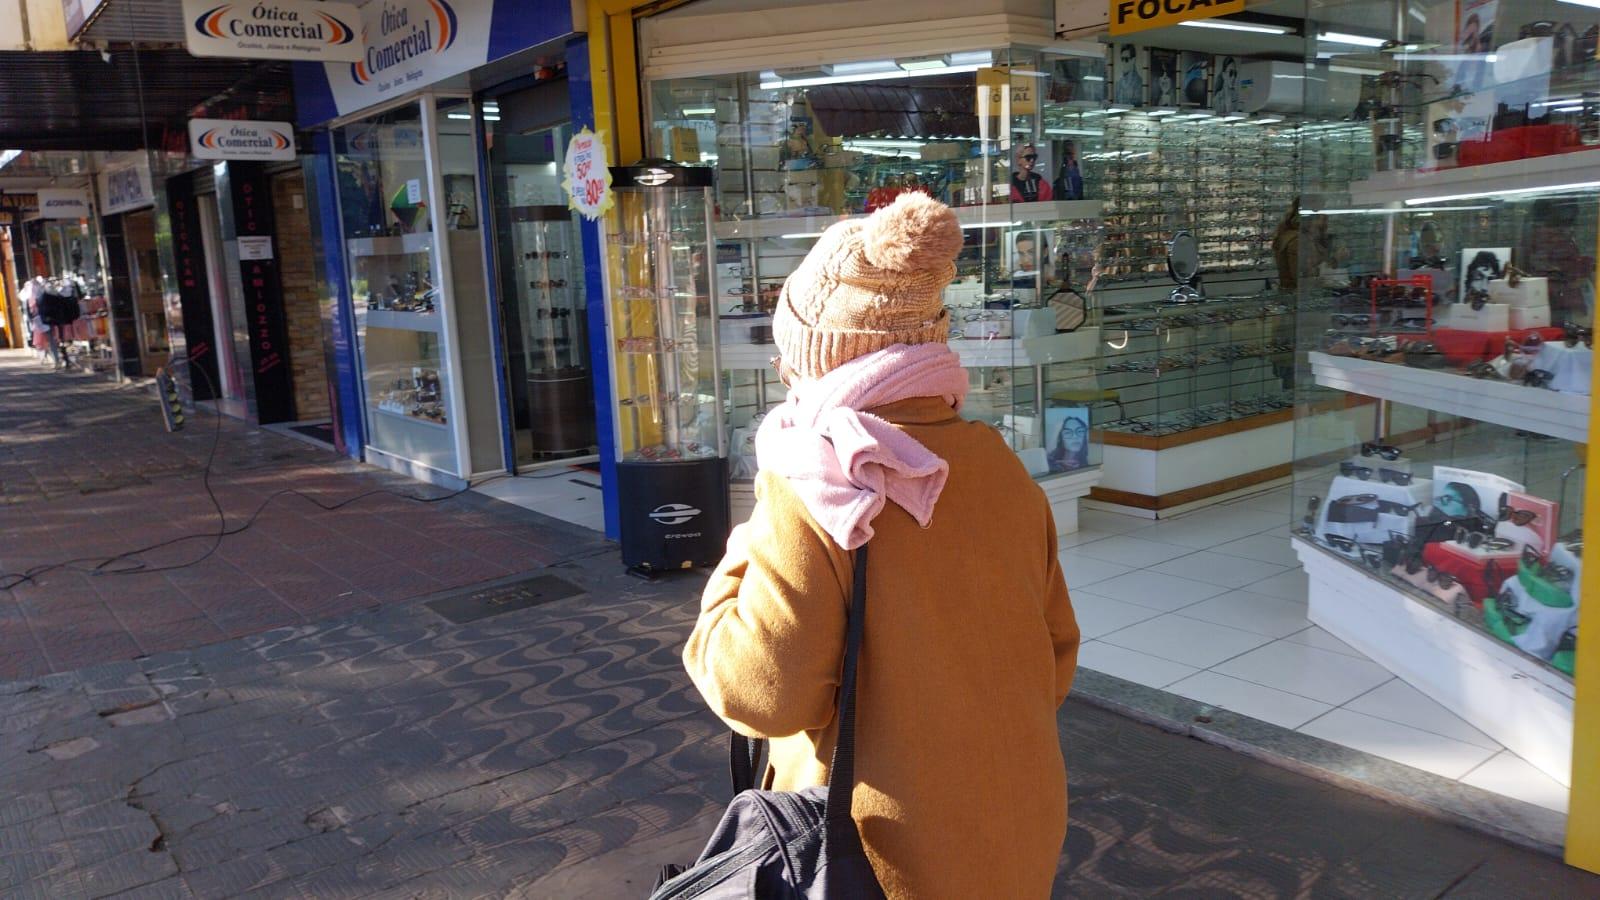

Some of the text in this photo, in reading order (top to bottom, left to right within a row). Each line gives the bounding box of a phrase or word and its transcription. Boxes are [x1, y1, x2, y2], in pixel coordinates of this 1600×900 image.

[252, 2, 299, 21] Ótica
[381, 1, 409, 36] Ótica
[1118, 0, 1235, 24] FOC
[230, 19, 323, 40] Comercial
[368, 20, 433, 74] Comercial
[218, 136, 272, 148] Comercial
[230, 125, 258, 137] Ótica
[243, 184, 256, 231] OTIC
